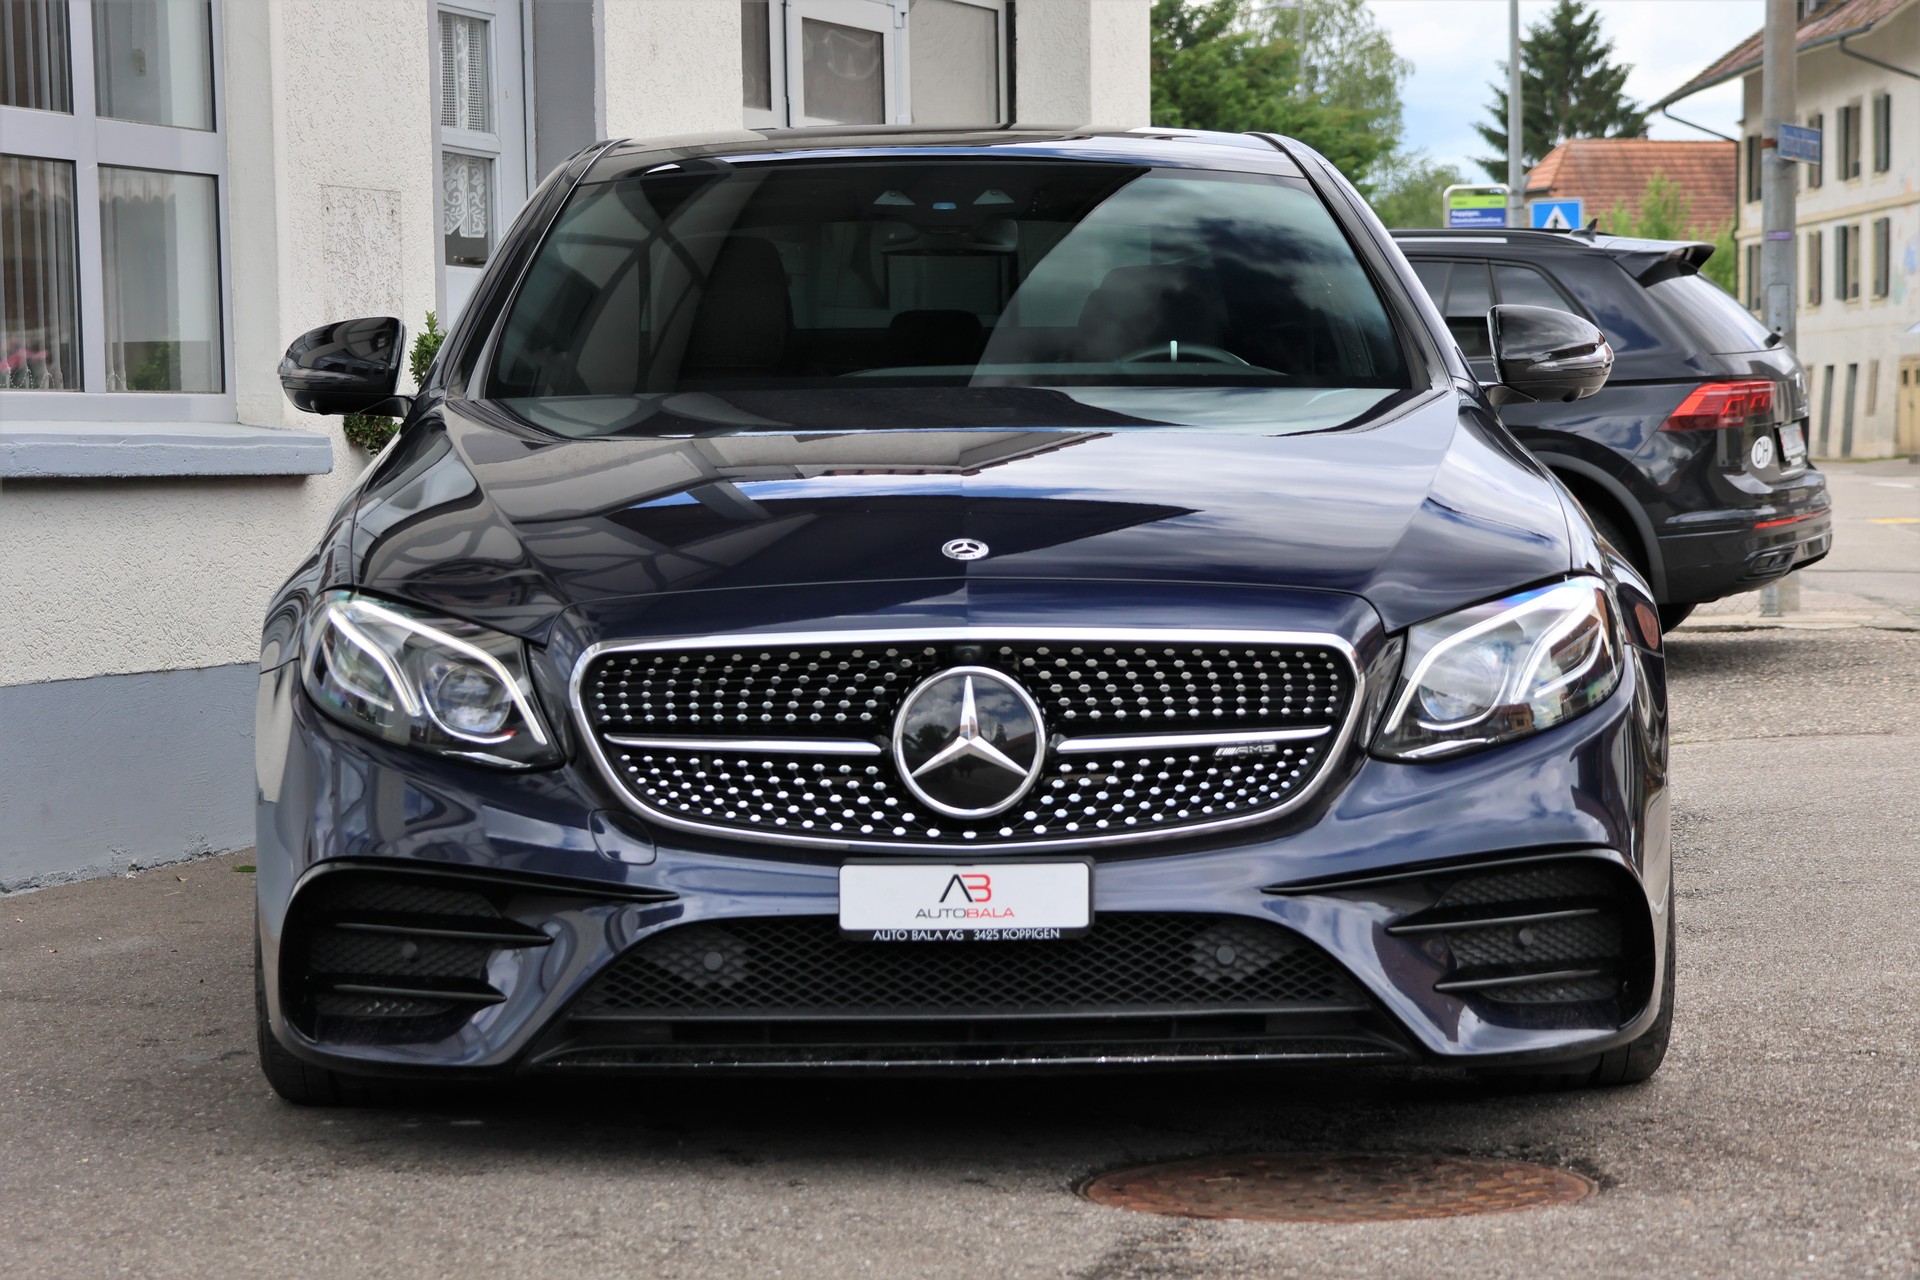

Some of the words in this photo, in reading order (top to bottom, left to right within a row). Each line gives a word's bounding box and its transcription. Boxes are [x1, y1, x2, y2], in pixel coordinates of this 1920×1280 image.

[1755, 440, 1770, 464] CH
[915, 907, 1015, 919] AUTOBALA
[872, 929, 908, 941] AUTO
[911, 929, 943, 941] BALA
[945, 929, 964, 941] AG
[973, 928, 999, 940] 3425
[1002, 928, 1060, 940] KOPPIGEN
